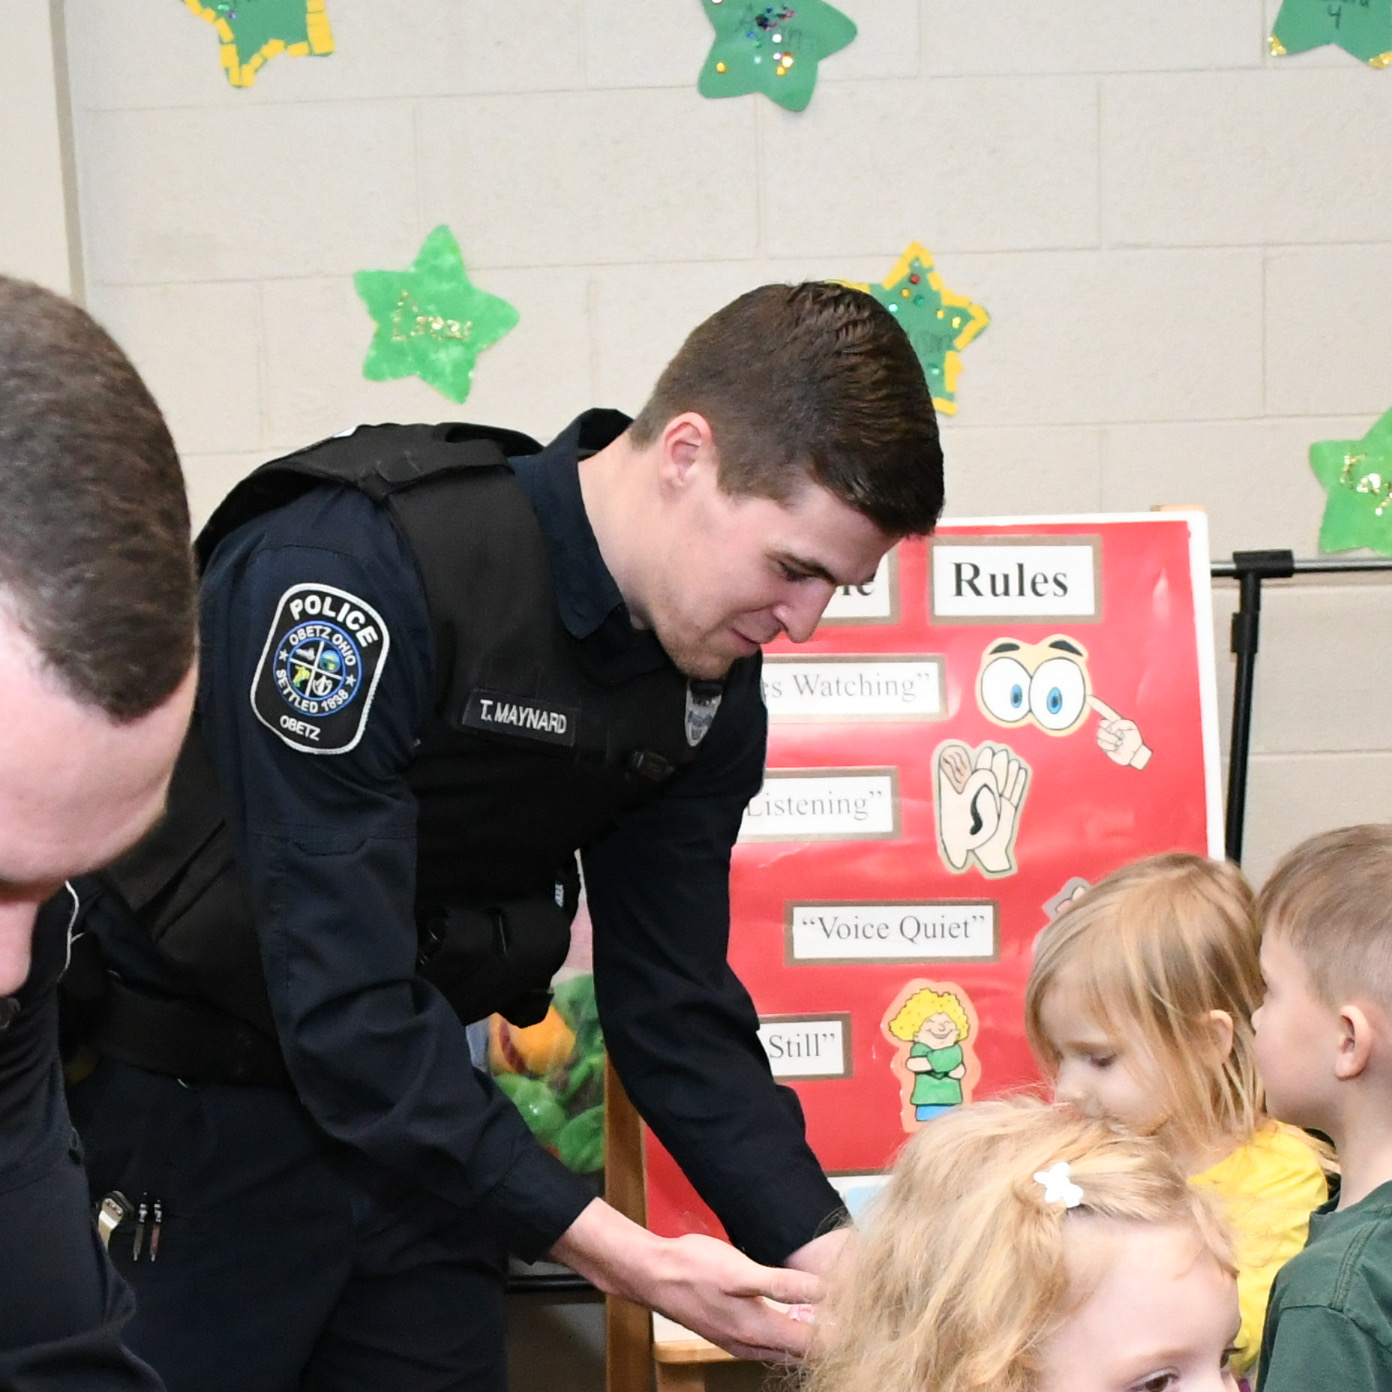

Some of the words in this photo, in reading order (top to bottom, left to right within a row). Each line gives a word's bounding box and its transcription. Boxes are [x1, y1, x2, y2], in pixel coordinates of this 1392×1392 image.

[1327, 4, 1343, 30] 4
[952, 561, 1069, 598] Rules
[288, 595, 378, 648] POLICE
[289, 624, 333, 646] OBETZ
[332, 633, 357, 667] OHIO
[276, 668, 319, 714] SETTLED
[321, 688, 349, 713] 1838
[279, 714, 322, 742] OBETZ
[494, 702, 567, 735] MAYNARD
